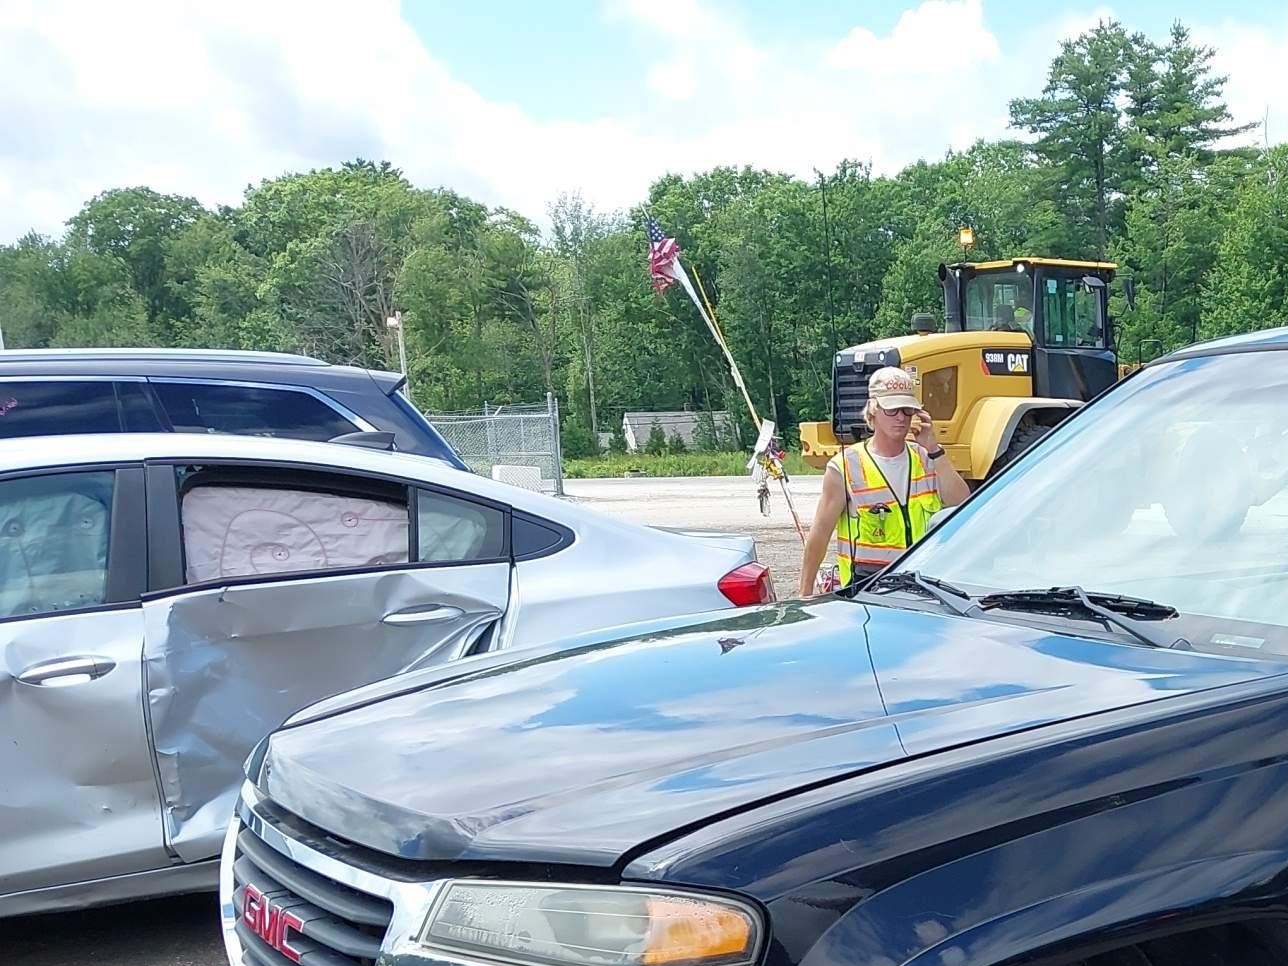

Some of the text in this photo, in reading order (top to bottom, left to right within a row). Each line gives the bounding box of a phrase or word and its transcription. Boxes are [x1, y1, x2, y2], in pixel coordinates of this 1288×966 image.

[985, 353, 1029, 372] 938M CAT
[242, 882, 305, 966] GMC
